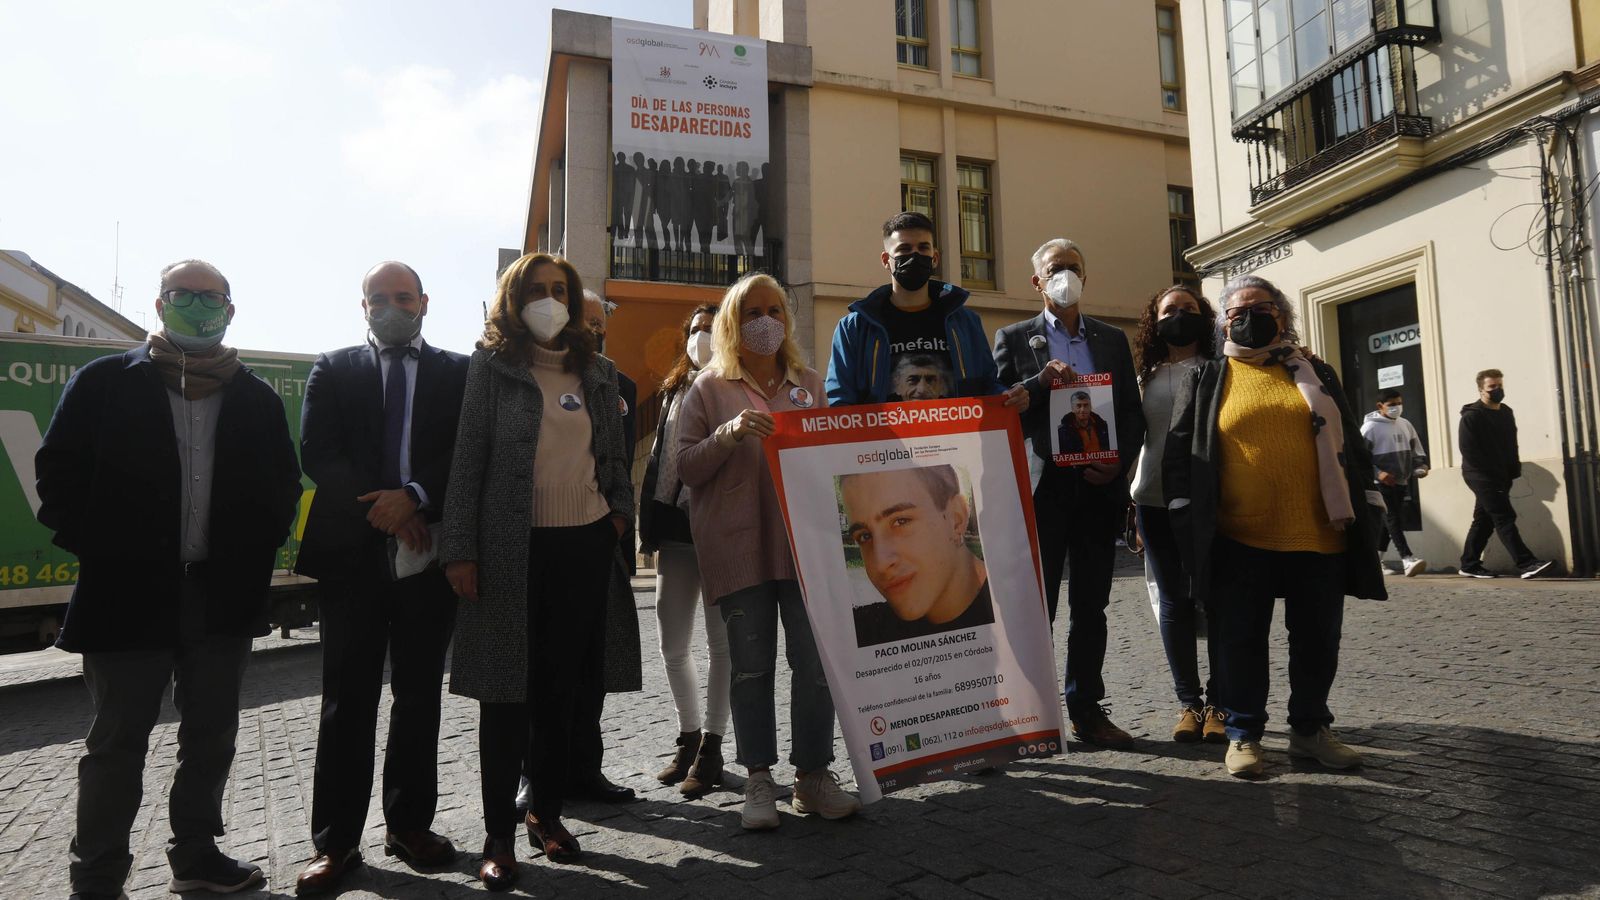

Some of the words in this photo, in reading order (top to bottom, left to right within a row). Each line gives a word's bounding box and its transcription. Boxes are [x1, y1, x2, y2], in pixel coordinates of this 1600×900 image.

[631, 95, 648, 109] DÍA
[653, 98, 667, 111] DE
[672, 100, 692, 114] LAS
[697, 102, 750, 119] PERSONAS
[631, 112, 752, 139] DESAPARECIDAS
[802, 414, 863, 433] MENOR
[866, 404, 984, 427] DESAPARECIDO
[857, 447, 913, 465] qsdglobal
[1052, 453, 1084, 462] RAFAEL
[1086, 451, 1118, 460] MURIEL
[875, 647, 898, 658] PACO
[901, 640, 937, 654] MOLINA
[938, 632, 976, 647] SÁNCHEZ
[855, 663, 902, 679] Desaparecido
[904, 661, 911, 669] el
[911, 653, 952, 668] 02/07/2015
[964, 645, 993, 657] Córdoba
[914, 675, 922, 684] 16
[925, 672, 941, 682] años
[858, 704, 883, 714] Teléfono
[884, 695, 917, 708] confidencial
[918, 692, 925, 700] de
[926, 691, 932, 699] la
[954, 674, 1004, 692] 689950710
[890, 716, 919, 730] MENOR
[920, 703, 980, 724] DESAPARECIDO
[981, 697, 1009, 710] 116000
[885, 743, 904, 757] (091),
[921, 735, 943, 747] (062),
[944, 731, 957, 742] 112
[965, 715, 1038, 737] info@qsdglobal.com
